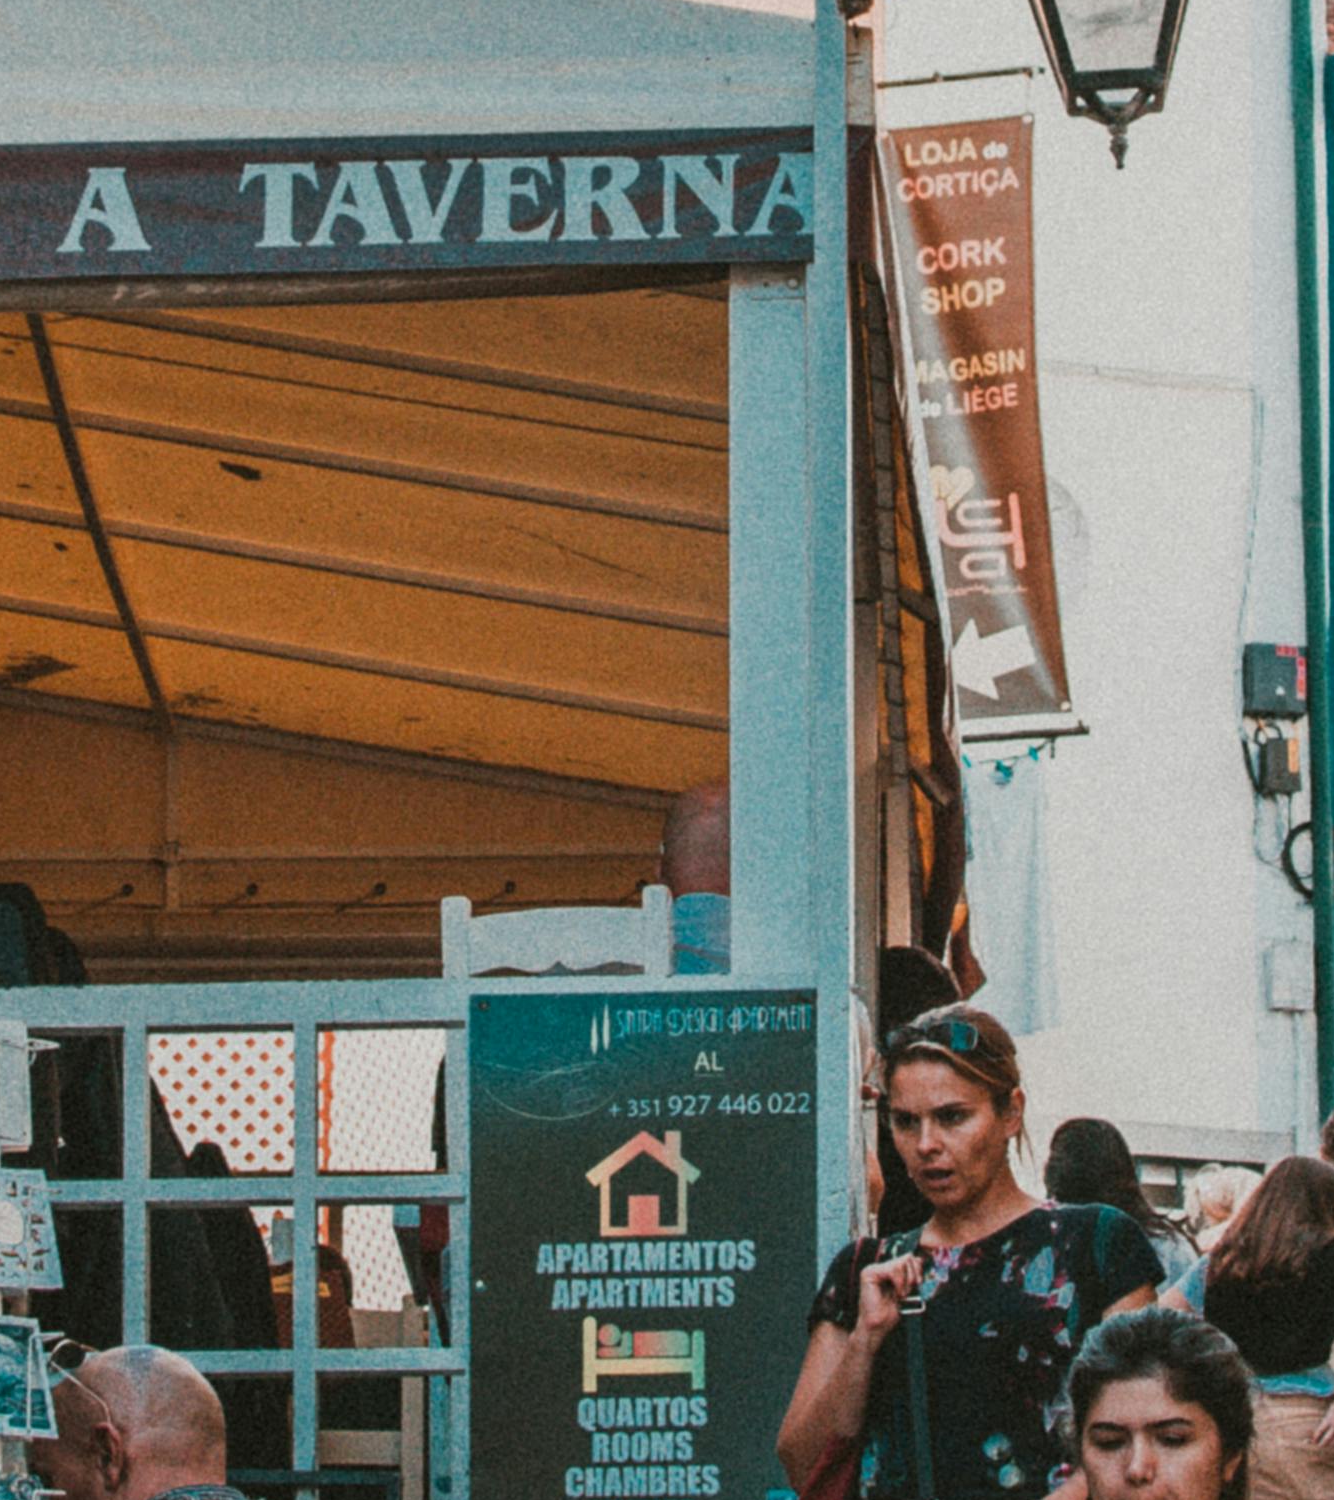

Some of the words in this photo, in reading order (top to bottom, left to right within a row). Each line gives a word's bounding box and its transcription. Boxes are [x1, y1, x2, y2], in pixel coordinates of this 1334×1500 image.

[904, 137, 978, 168] LOJA
[981, 140, 1009, 160] de
[896, 166, 1020, 203] CORTIÇA
[57, 167, 152, 253] A
[240, 152, 814, 249] TAVERNA
[916, 236, 1007, 275] CORK
[920, 276, 1006, 315] SHOP
[945, 383, 1019, 415] LIÈGE
[693, 1051, 725, 1072] AL
[627, 1098, 661, 1118] 351
[667, 1094, 712, 1117] 927
[717, 1093, 762, 1115] 446
[766, 1091, 812, 1115] 022
[535, 1239, 756, 1275] APARTAMENTOS
[551, 1276, 735, 1310] APARTMENTS
[576, 1396, 708, 1431] QUARTOS
[591, 1430, 693, 1463] ROOMS
[564, 1464, 720, 1498] CHAMBRES
